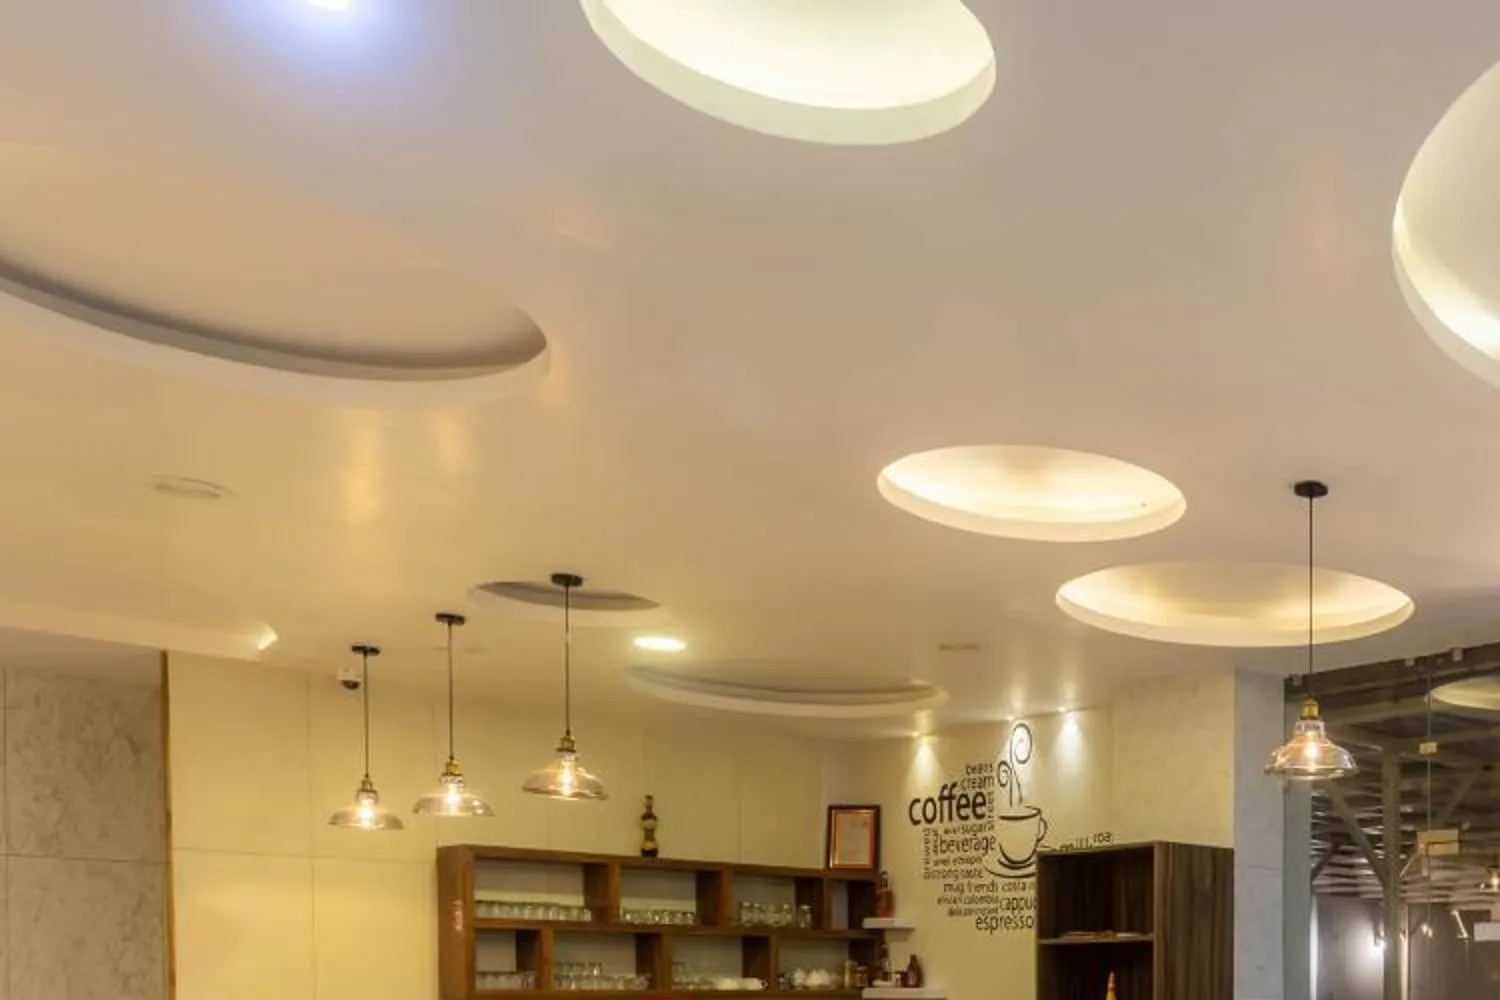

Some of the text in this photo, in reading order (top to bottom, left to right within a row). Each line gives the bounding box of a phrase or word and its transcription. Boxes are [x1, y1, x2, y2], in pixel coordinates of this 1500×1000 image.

[961, 775, 995, 791] cream
[908, 781, 987, 827] coffee
[939, 835, 997, 857] beverage
[975, 915, 1035, 935] espresso
